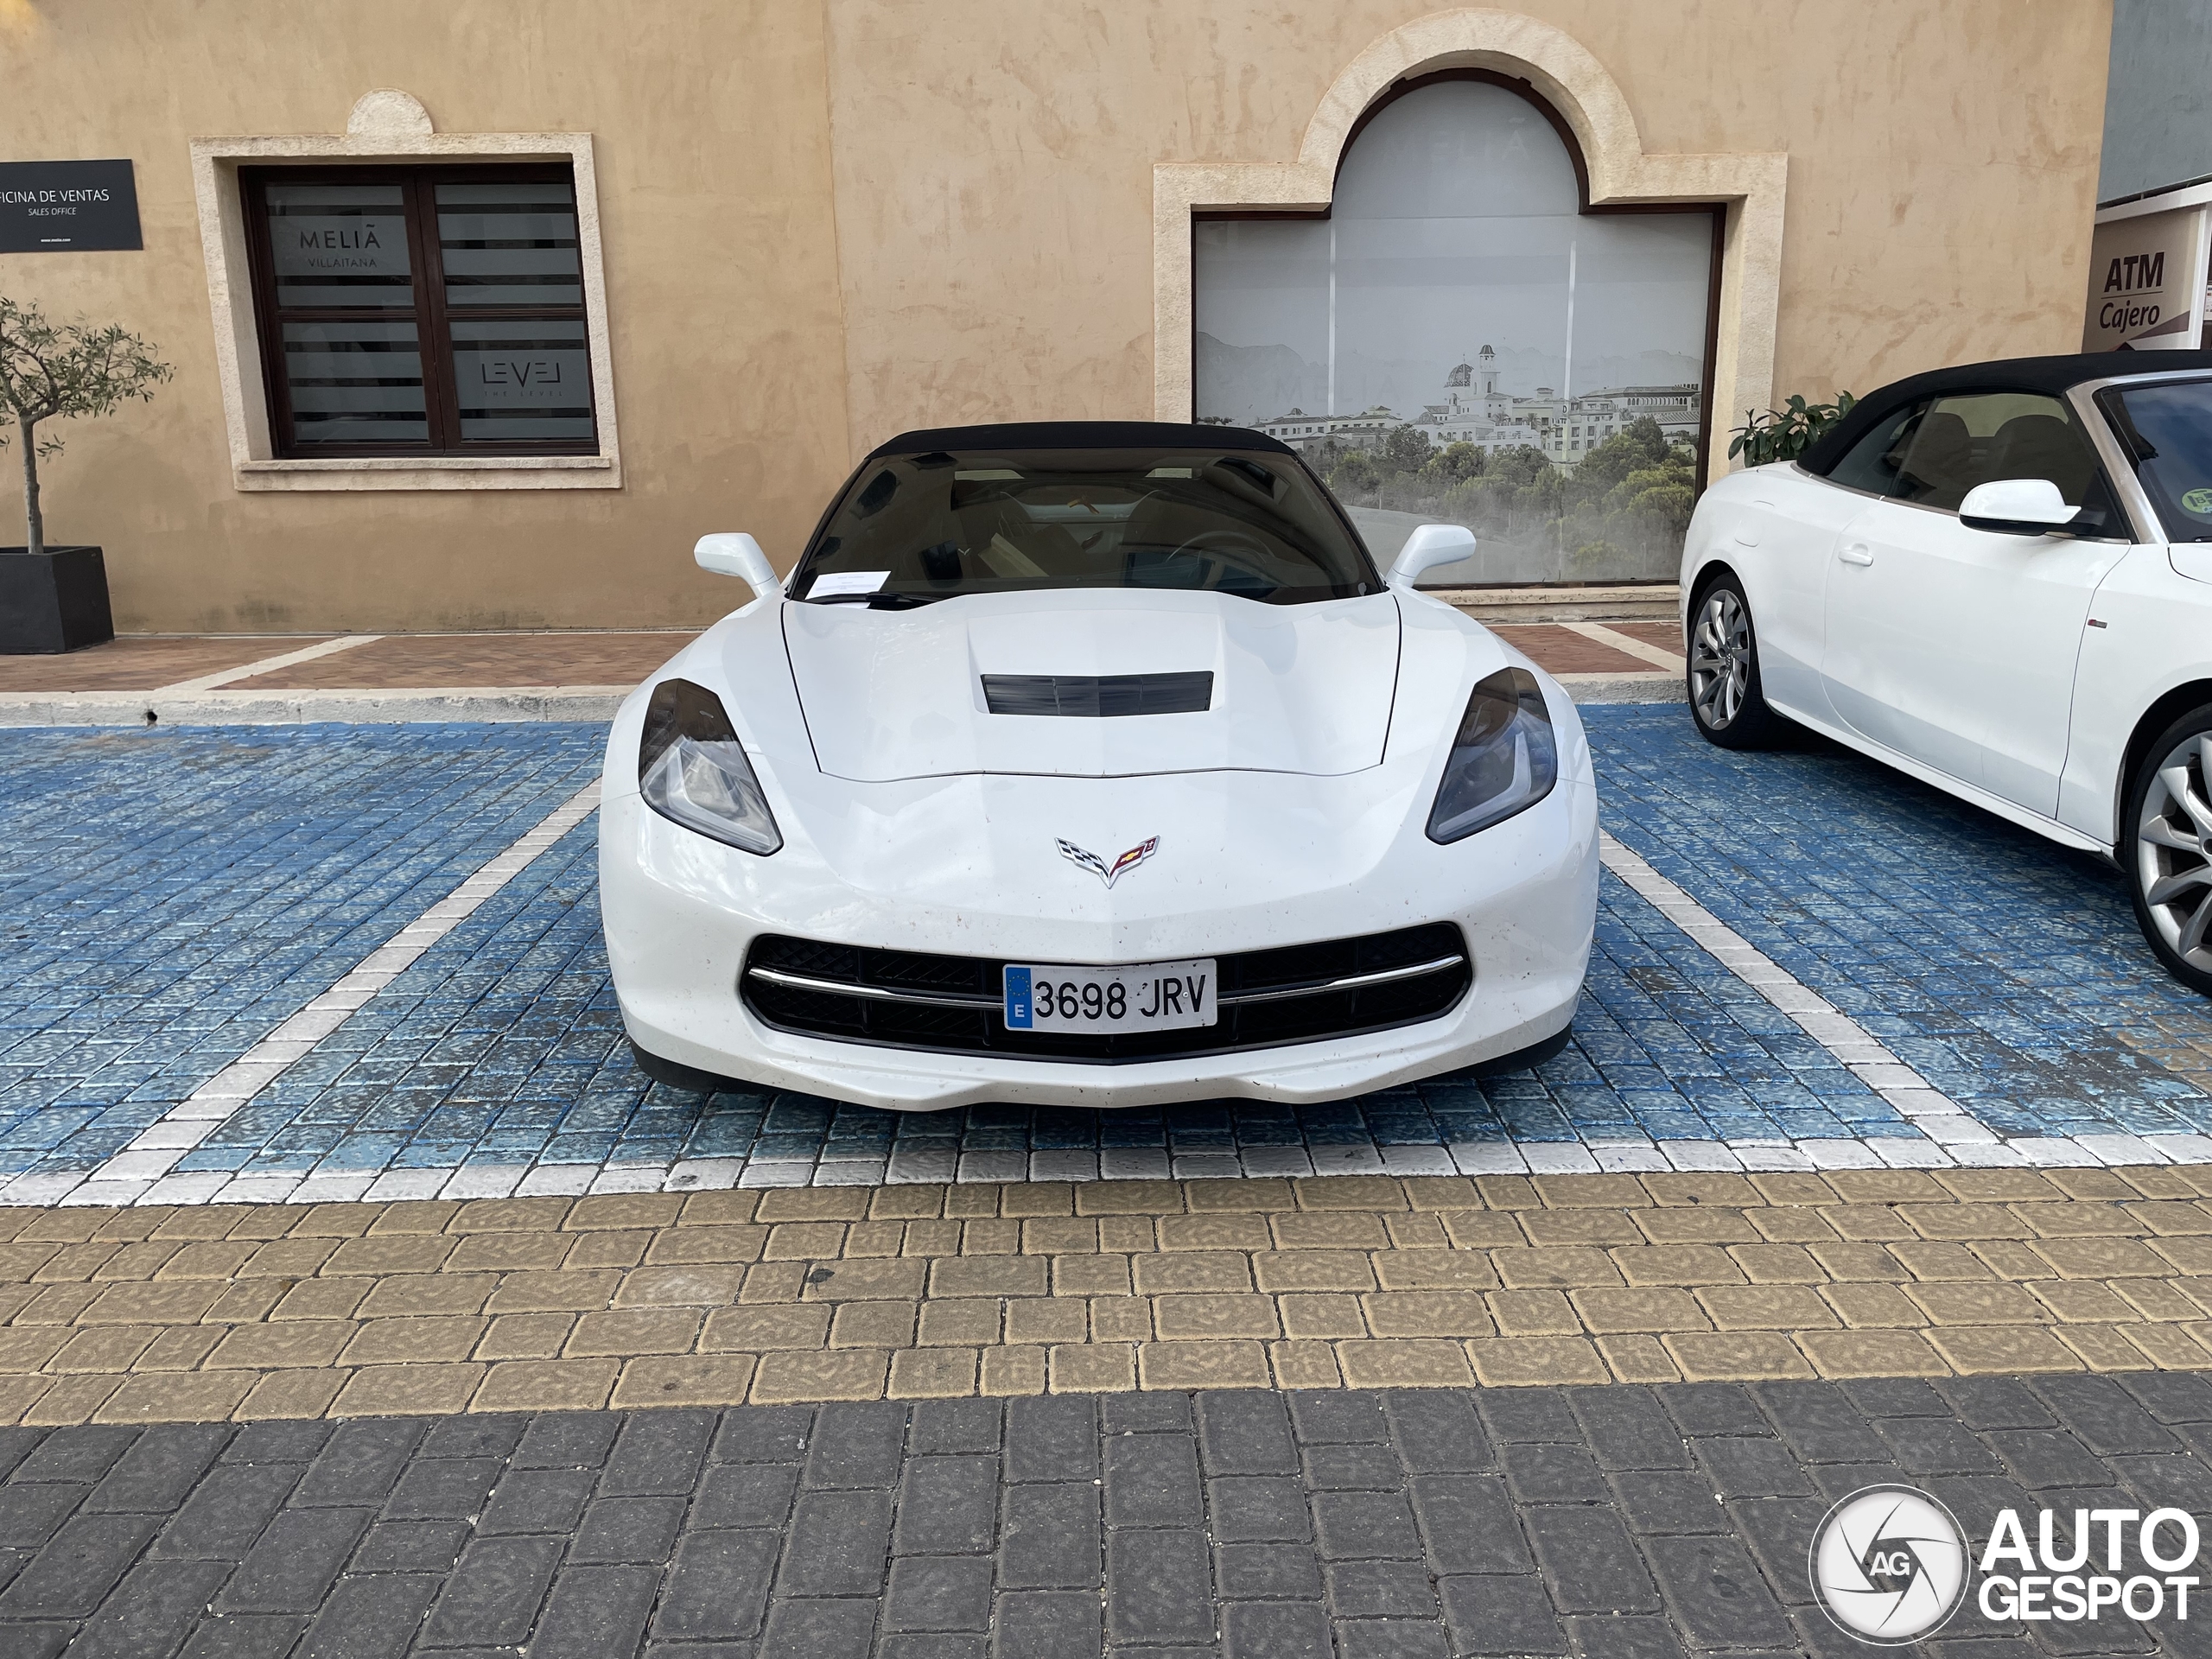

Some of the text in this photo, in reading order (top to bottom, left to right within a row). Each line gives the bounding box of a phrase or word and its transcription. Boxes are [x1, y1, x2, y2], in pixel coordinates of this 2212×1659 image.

[39, 190, 57, 202] DE
[59, 188, 110, 202] VENTAS
[51, 207, 77, 215] OFFICE
[299, 224, 381, 249] MELIÃ
[308, 258, 378, 268] VILLAITANA
[2103, 251, 2165, 292] ATM
[2100, 300, 2160, 334] Cajero
[481, 362, 561, 388] LEVEL
[1034, 982, 1127, 1020] 3698
[1139, 975, 1206, 1017] JRV
[1014, 1004, 1025, 1018] E
